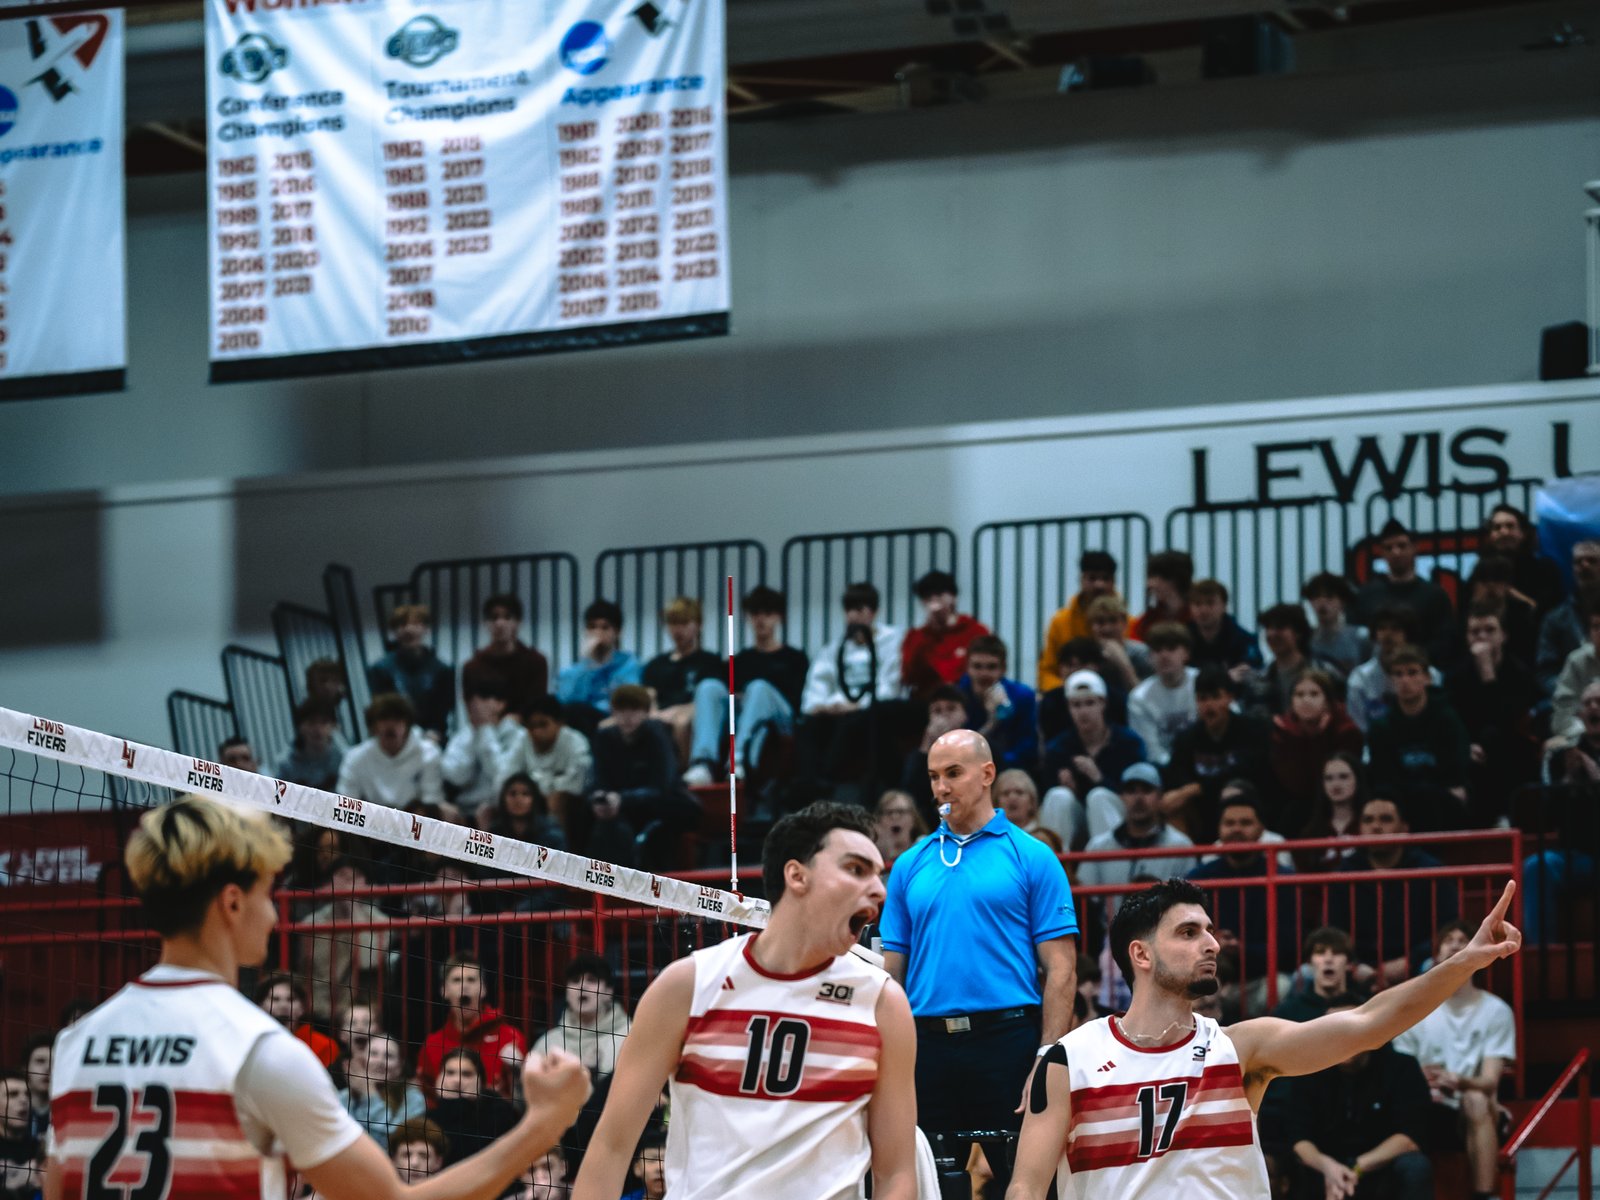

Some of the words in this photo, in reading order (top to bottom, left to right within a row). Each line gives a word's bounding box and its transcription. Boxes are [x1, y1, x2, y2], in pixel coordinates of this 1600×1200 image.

[1191, 427, 1510, 507] LEWIS
[34, 718, 64, 735] LEWIS
[28, 731, 67, 753] FLYERS
[193, 759, 220, 776] LEWIS
[187, 771, 223, 792] FLYERS
[338, 796, 362, 812] LEWIS
[333, 808, 365, 827] FLYERS
[470, 829, 492, 844] LEWIS
[465, 841, 494, 859] FLYERS
[591, 860, 611, 873] LEWIS
[586, 870, 614, 887] FLYERS
[819, 983, 849, 999] 30
[82, 1036, 197, 1066] LEWIS
[739, 1015, 811, 1096] 10
[1135, 1081, 1188, 1158] 17
